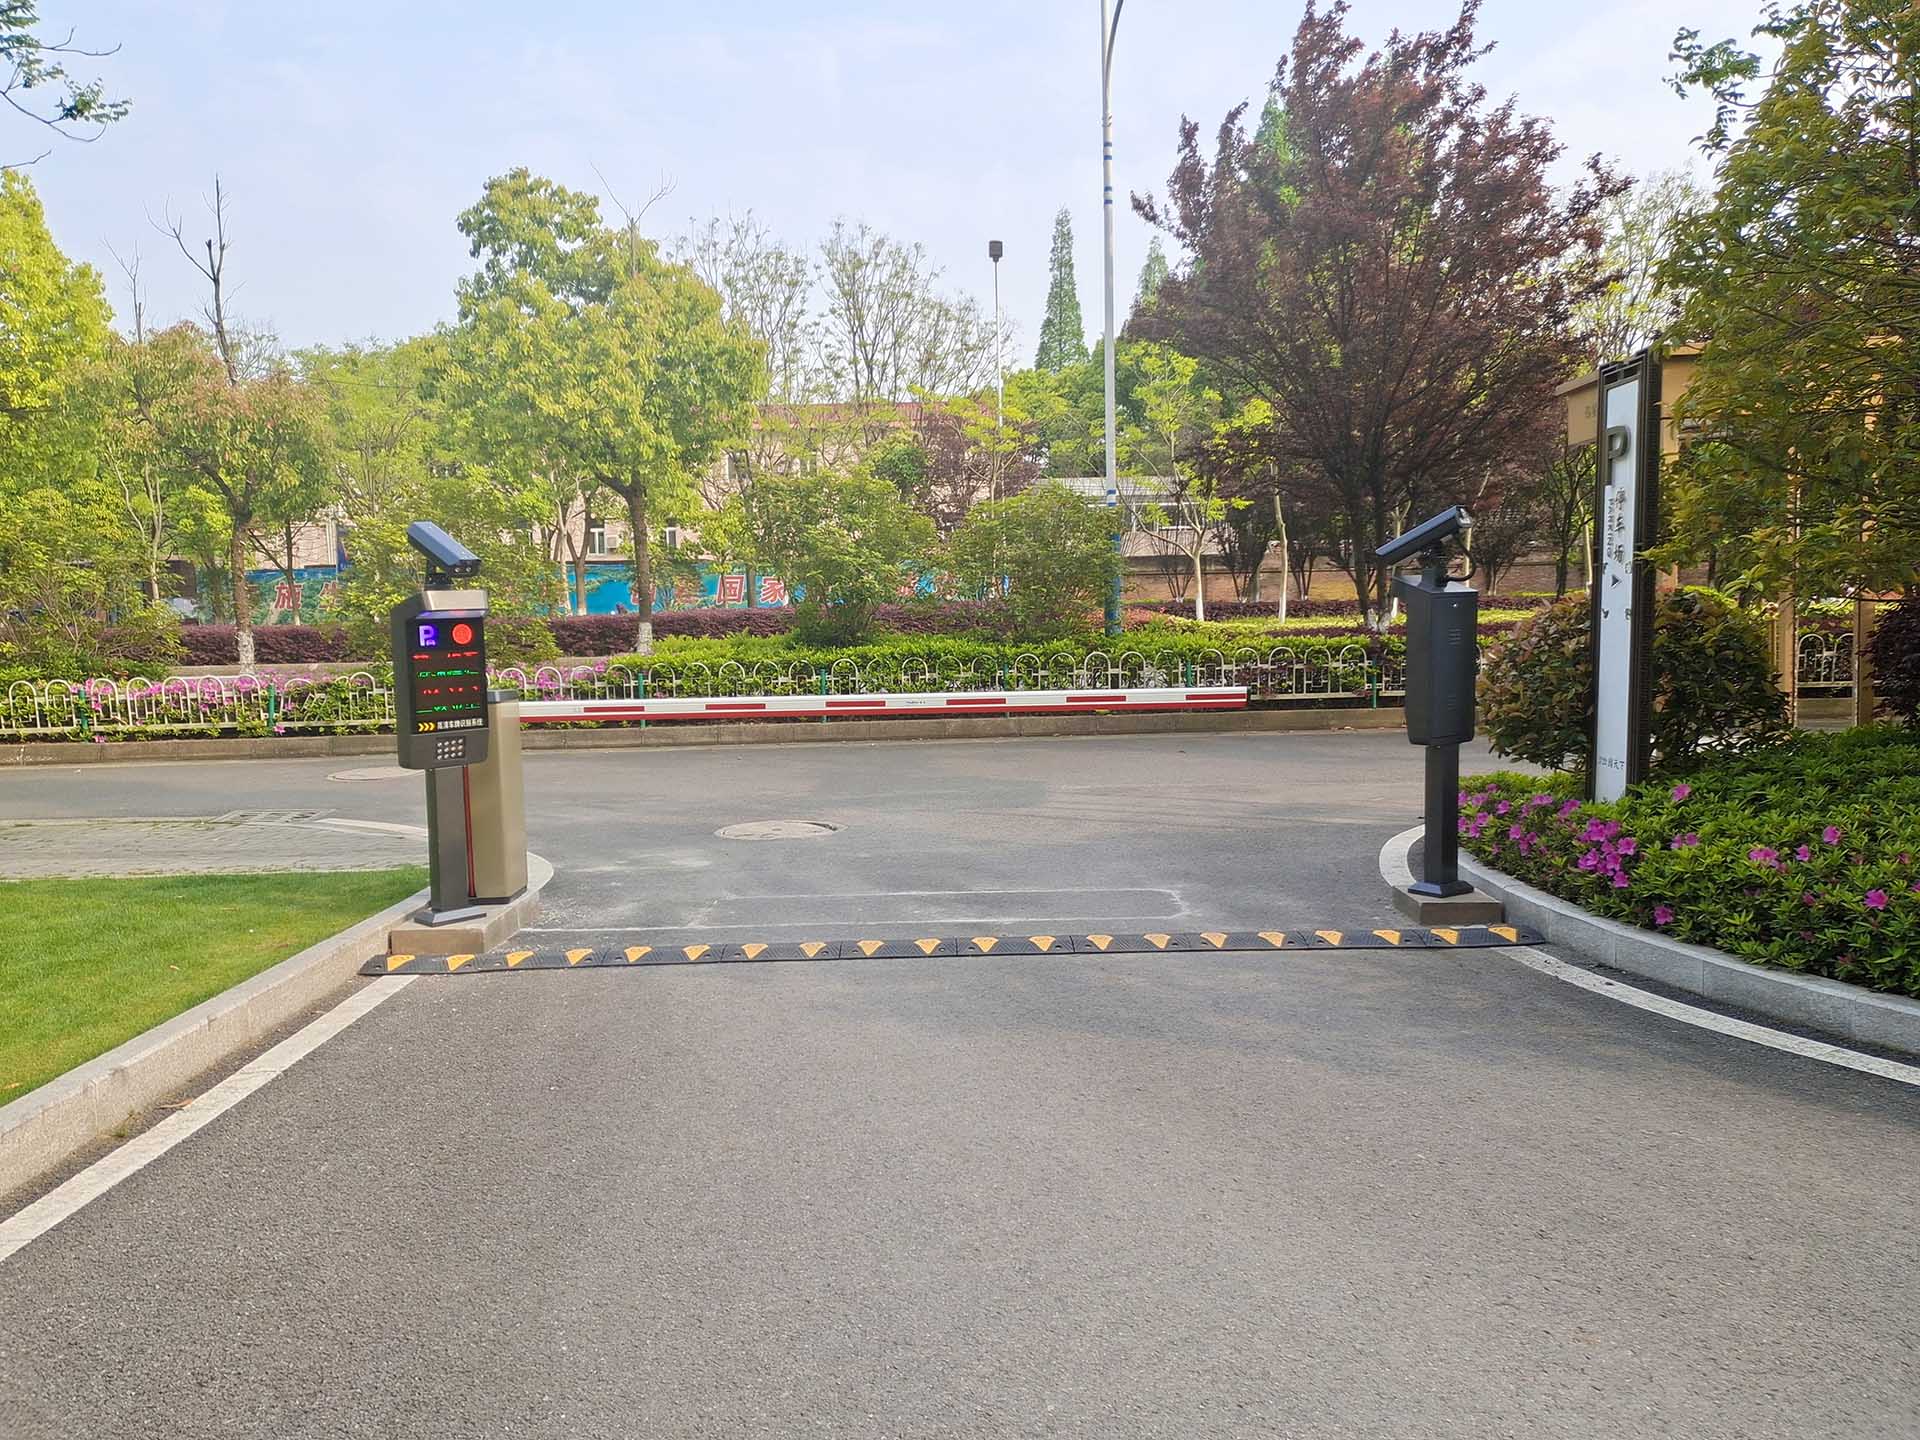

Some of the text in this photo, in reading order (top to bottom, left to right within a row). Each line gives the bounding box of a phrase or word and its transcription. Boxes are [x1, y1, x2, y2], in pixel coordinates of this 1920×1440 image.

[1601, 426, 1628, 485] P
[1614, 487, 1625, 563] 停车场
[419, 626, 435, 646] P
